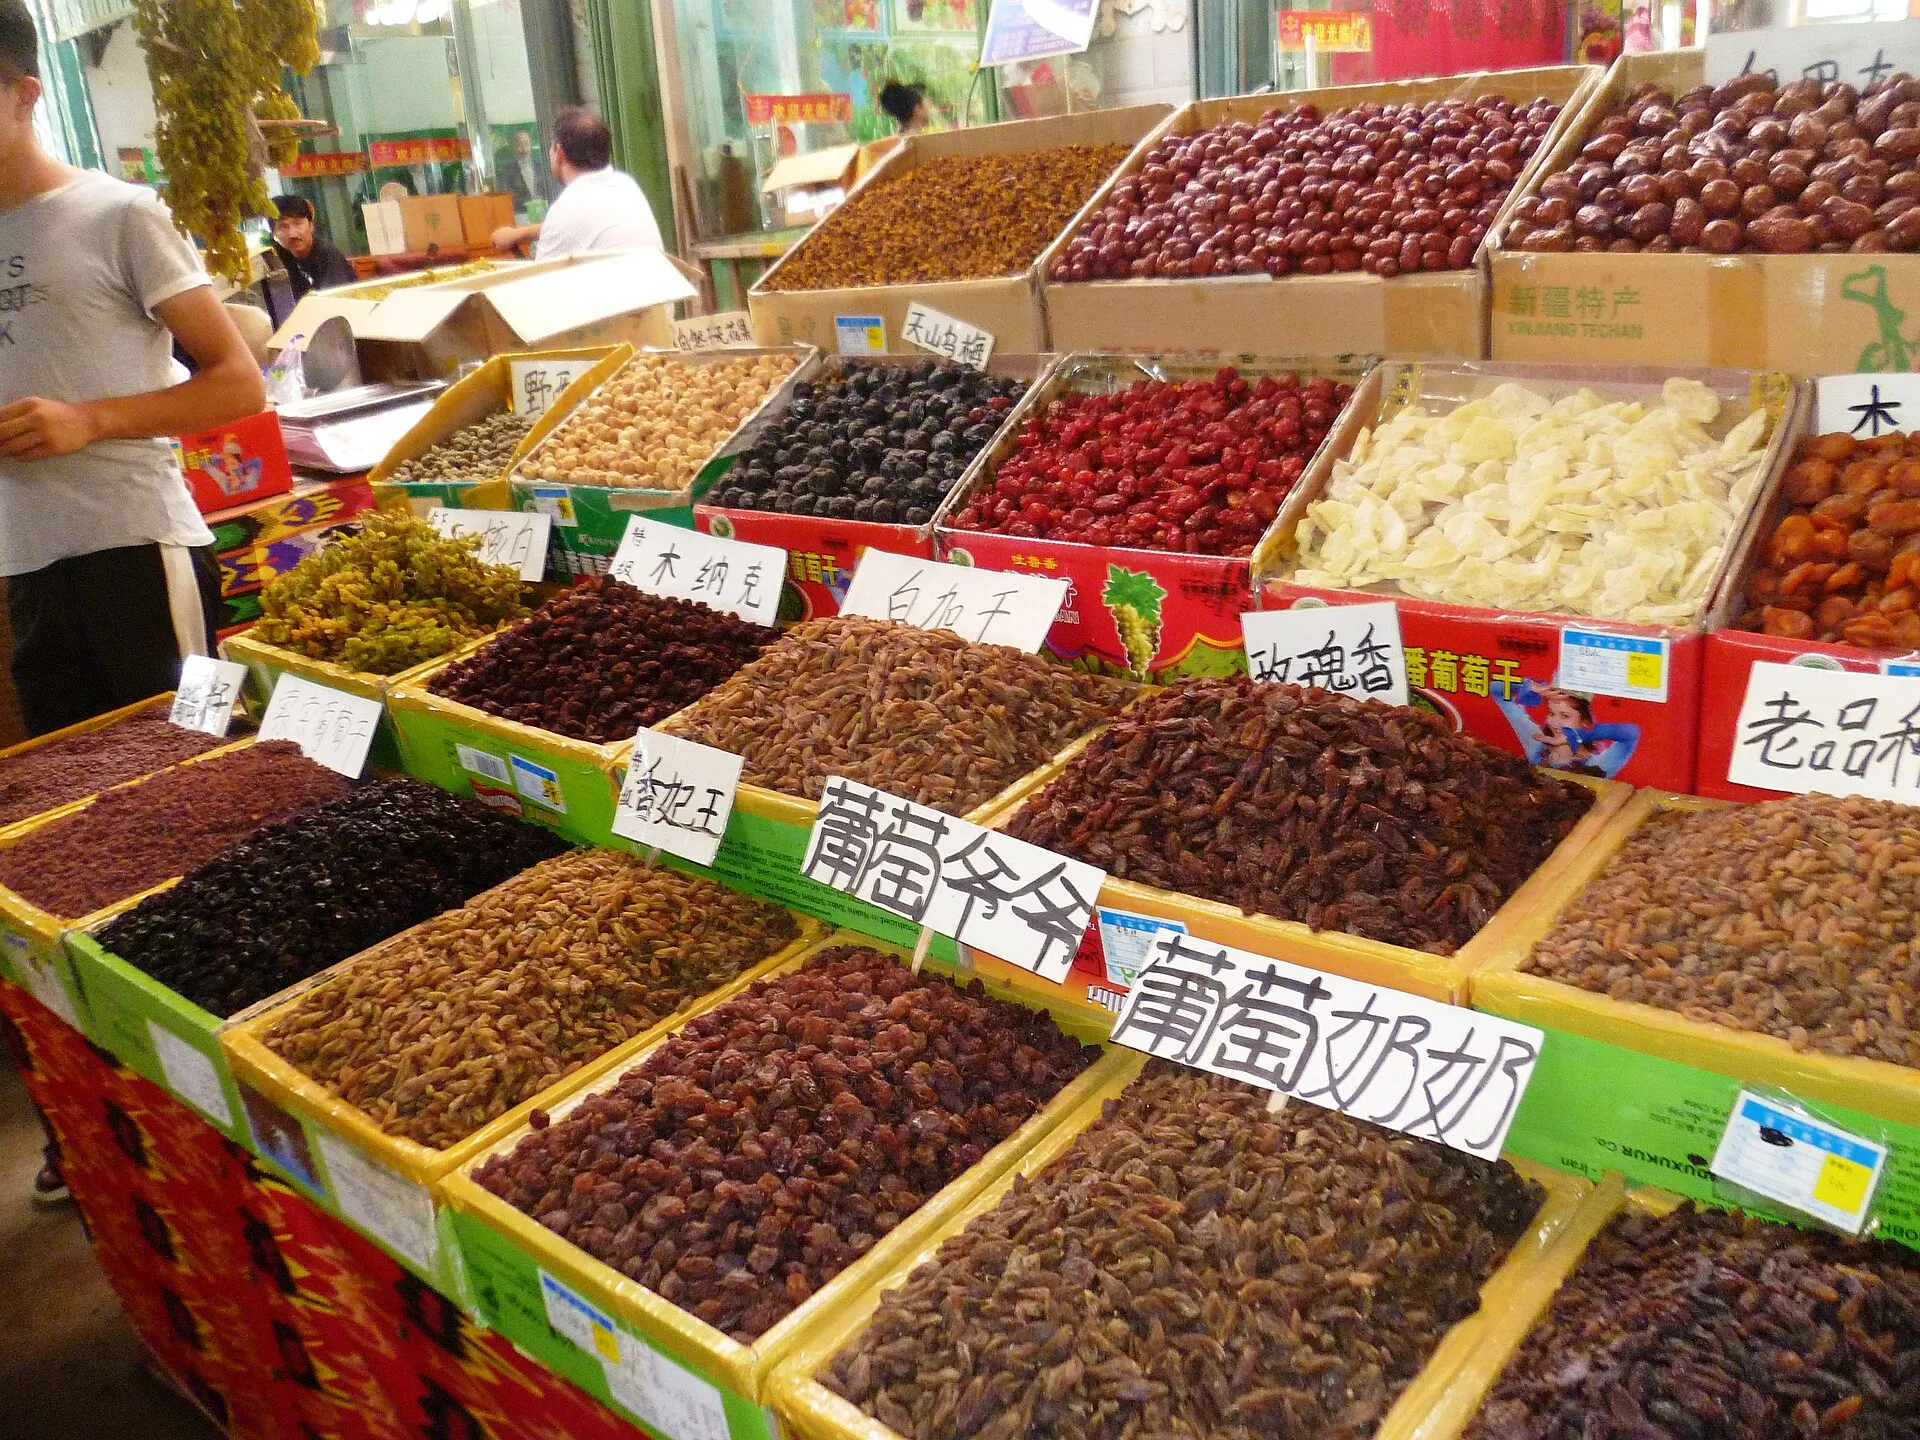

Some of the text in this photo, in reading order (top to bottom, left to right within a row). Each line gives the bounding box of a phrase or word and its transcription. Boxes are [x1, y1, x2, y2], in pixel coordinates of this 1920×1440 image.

[1301, 21, 1350, 45] 欢迎光临
[772, 101, 829, 120] 欢迎光临
[1507, 321, 1643, 339] XINJIANG TECHAN
[1510, 284, 1642, 321] 新疆特产
[905, 311, 987, 364] 天山乌梅
[648, 542, 764, 609] 木纳克
[1010, 554, 1059, 571] 吐鲁番
[888, 569, 1020, 644] 白加干
[1250, 621, 1395, 694] 玫瑰香
[1404, 646, 1524, 701] 番葡萄干
[636, 755, 724, 839] 香妃王
[805, 780, 1093, 972] 葡萄爷爷
[1111, 935, 1538, 1151] 葡萄奶奶
